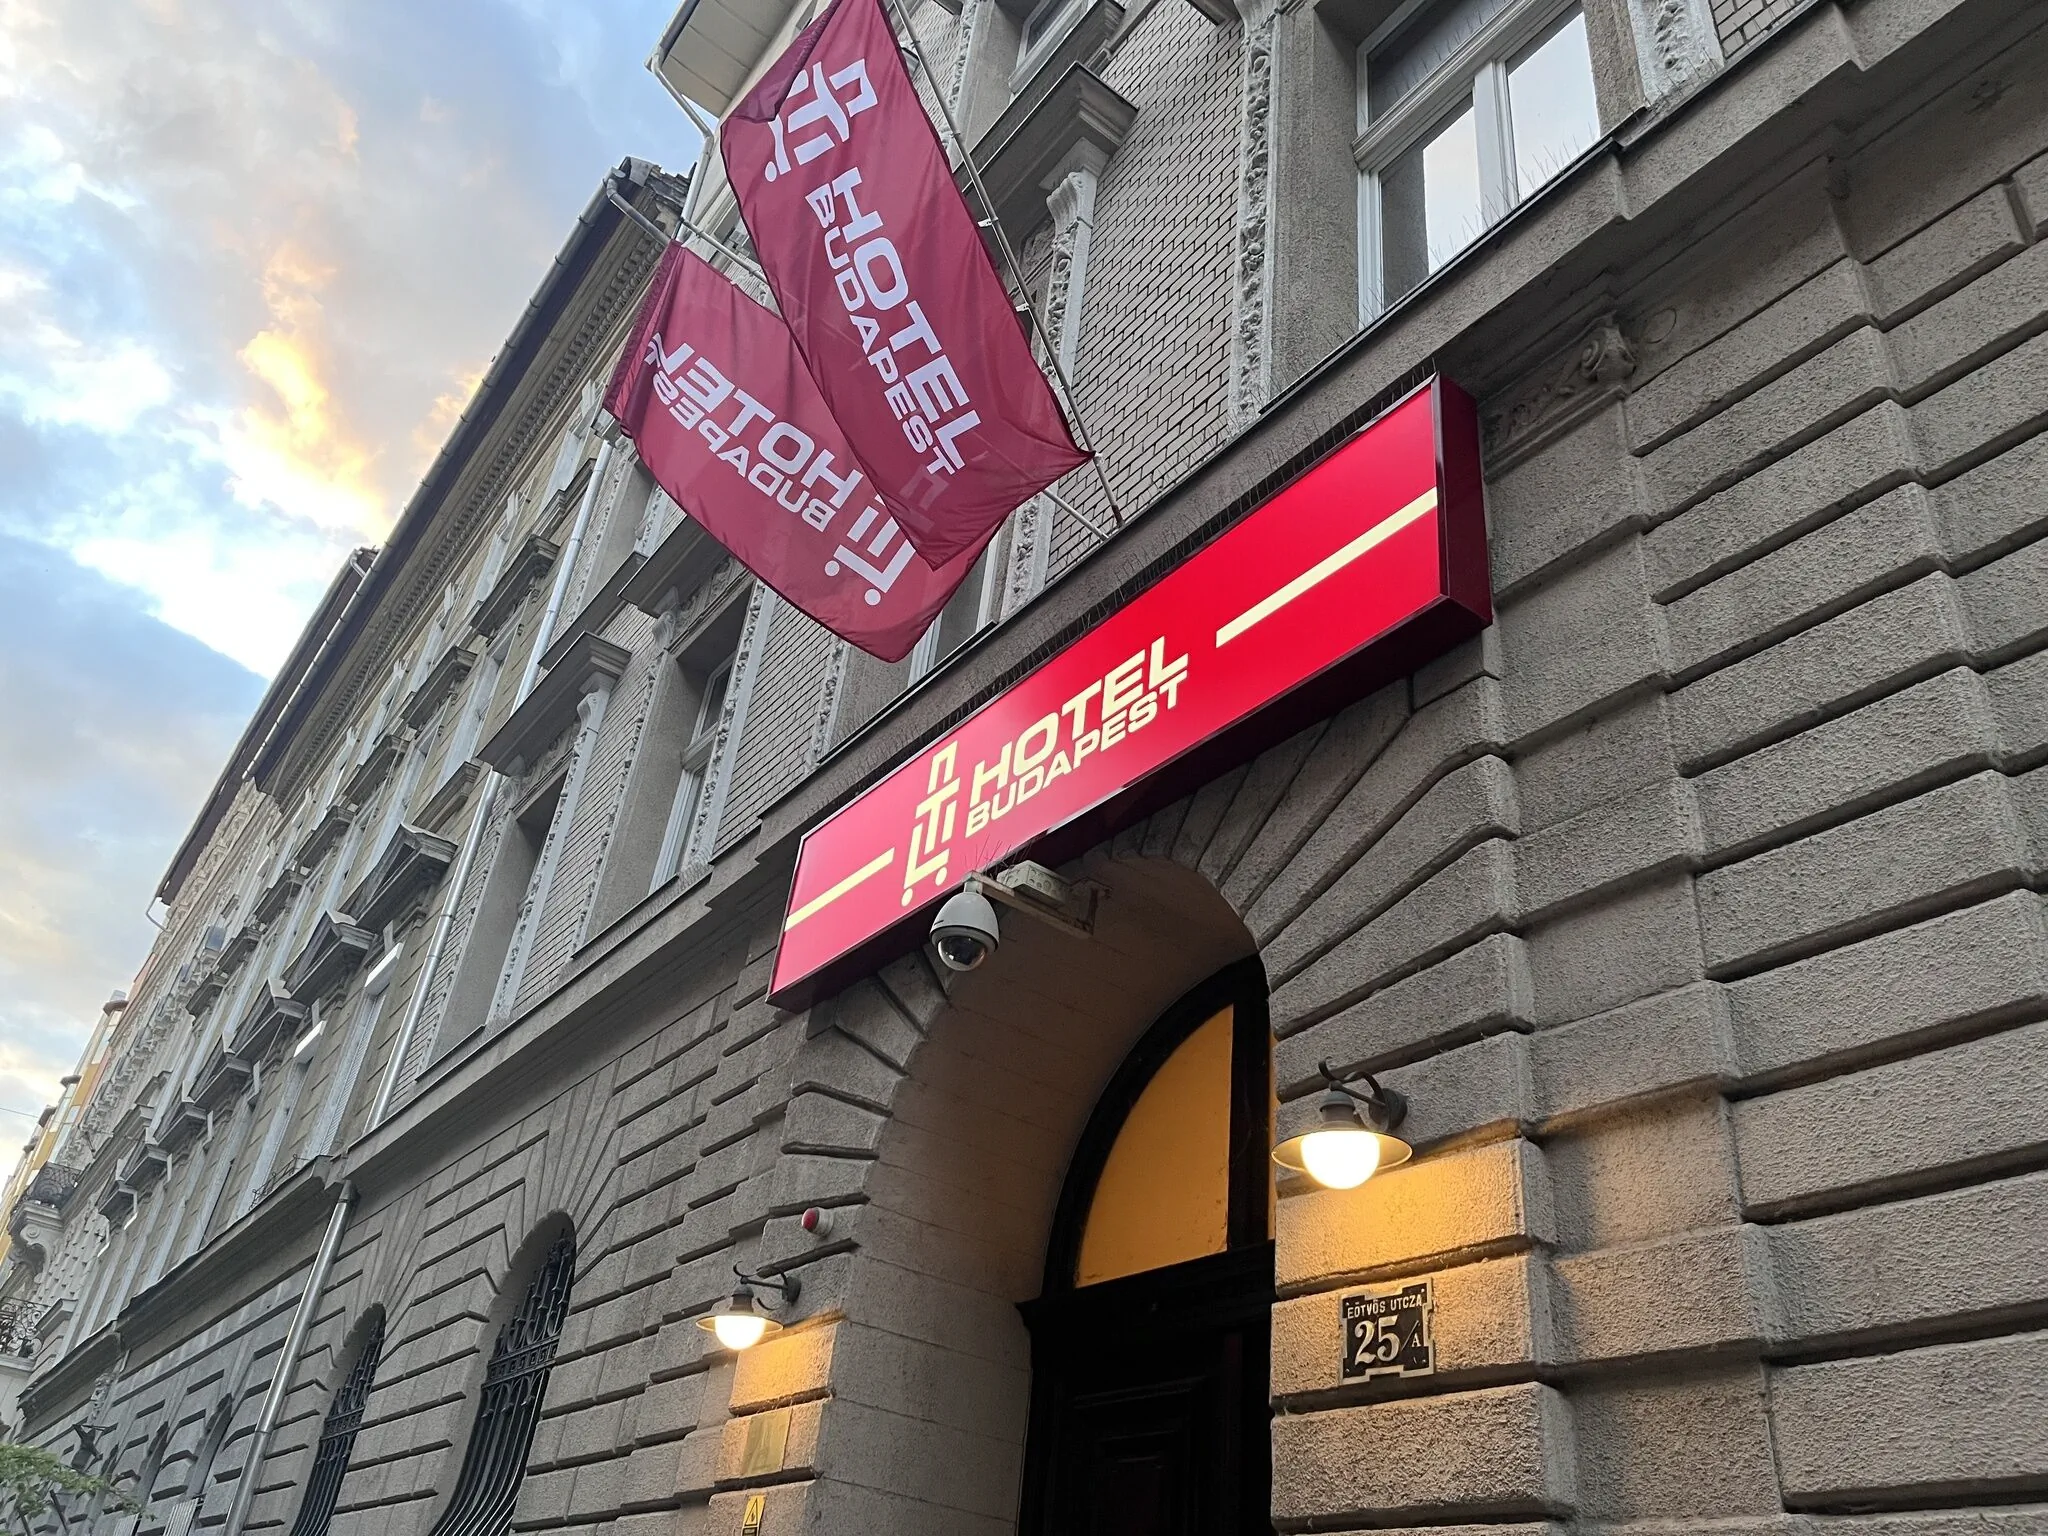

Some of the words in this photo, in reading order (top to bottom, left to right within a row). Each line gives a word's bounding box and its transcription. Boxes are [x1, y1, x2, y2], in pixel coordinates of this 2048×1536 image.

[804, 182, 955, 475] BUDAPEST
[831, 166, 982, 475] HOTEL
[964, 669, 1188, 839] BUDAPEST
[969, 635, 1189, 809] HOTEL
[1390, 1293, 1422, 1312] UTCZA
